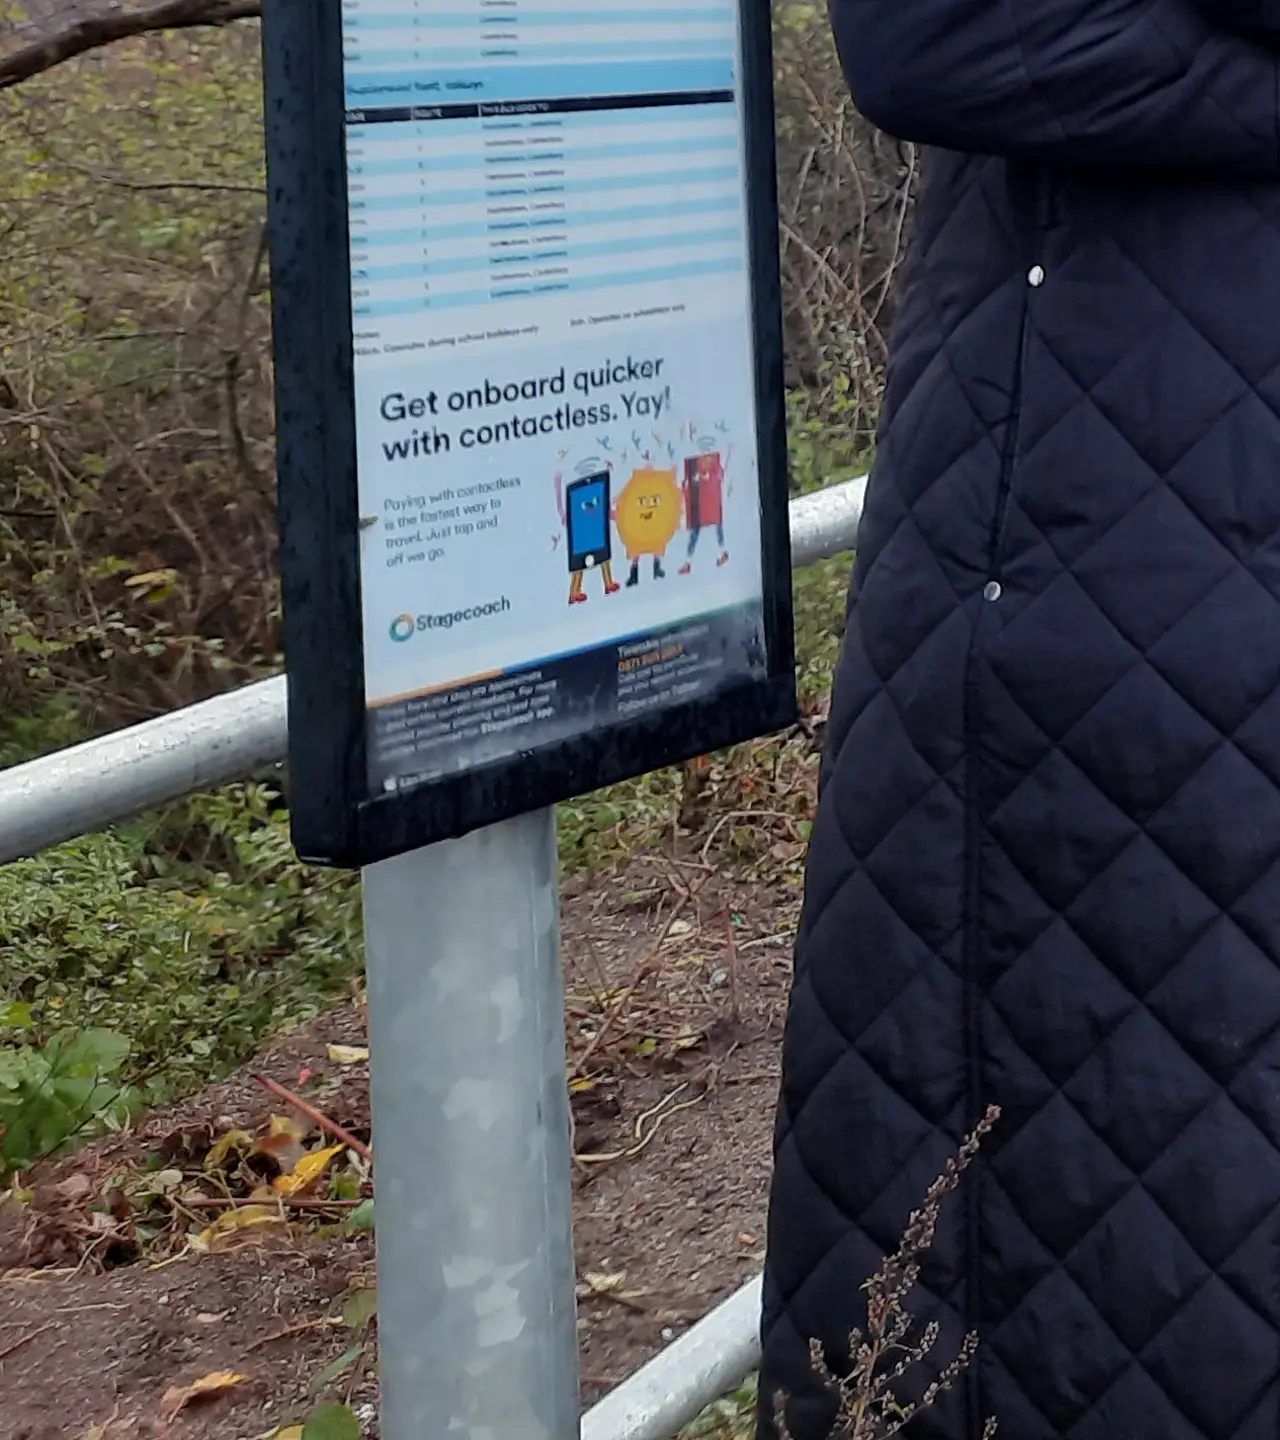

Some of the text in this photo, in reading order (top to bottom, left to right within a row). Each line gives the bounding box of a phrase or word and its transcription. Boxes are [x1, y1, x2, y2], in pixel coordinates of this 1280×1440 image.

[380, 355, 664, 421] Get onboard quicker
[381, 385, 671, 461] with contactless. Yay!
[384, 477, 521, 511] Paying with contactless
[384, 498, 502, 531] is the fastest way to
[426, 526, 452, 542] Just
[454, 522, 474, 536] tap
[476, 516, 499, 531] and
[386, 551, 404, 568] off
[407, 551, 426, 563] we
[416, 594, 511, 632] Stagecoach
